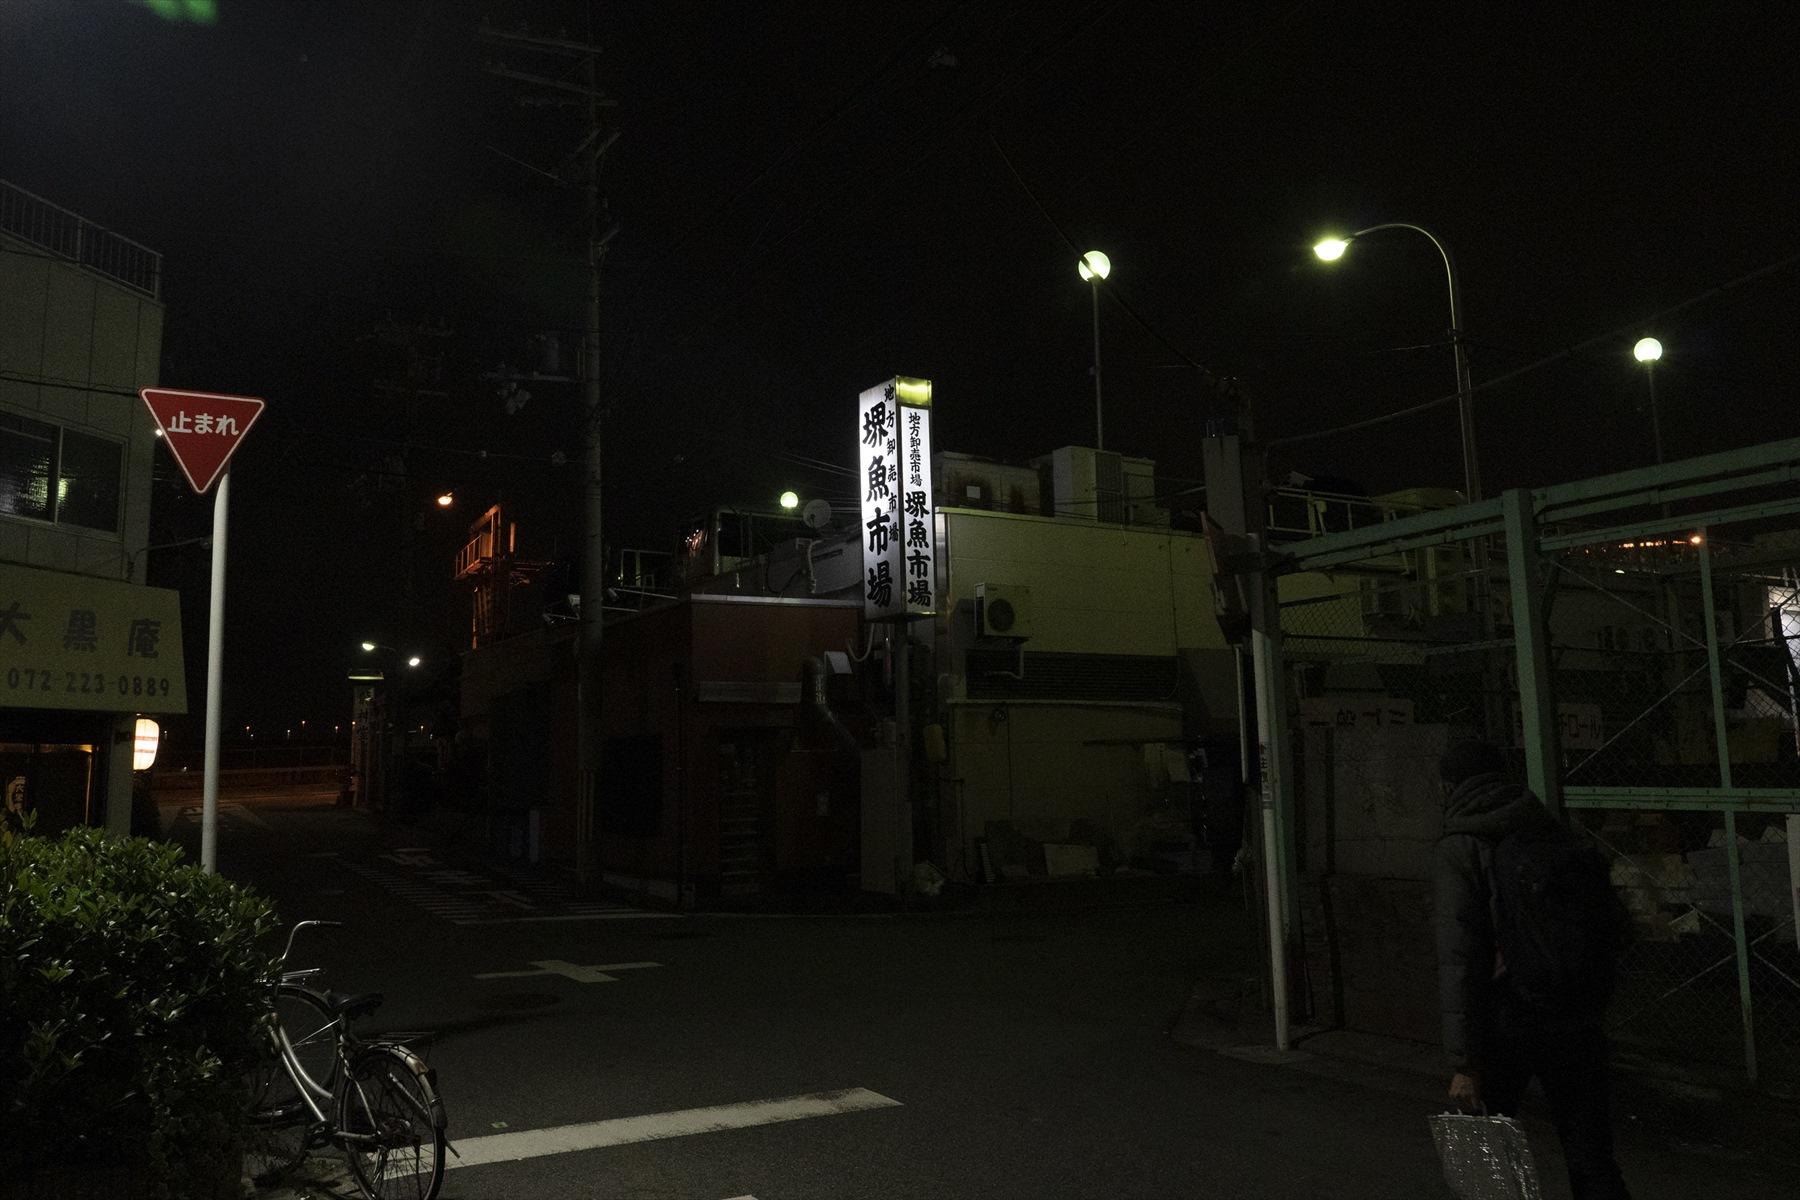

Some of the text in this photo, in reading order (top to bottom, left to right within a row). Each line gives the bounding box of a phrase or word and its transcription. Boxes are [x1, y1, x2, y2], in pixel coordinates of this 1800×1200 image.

[167, 410, 240, 436] 止まれ
[884, 384, 899, 542] 地方卸売市場
[908, 412, 922, 487] 地方卸売市場
[862, 401, 893, 608] 堺魚市場
[904, 490, 933, 608] 堺魚市場
